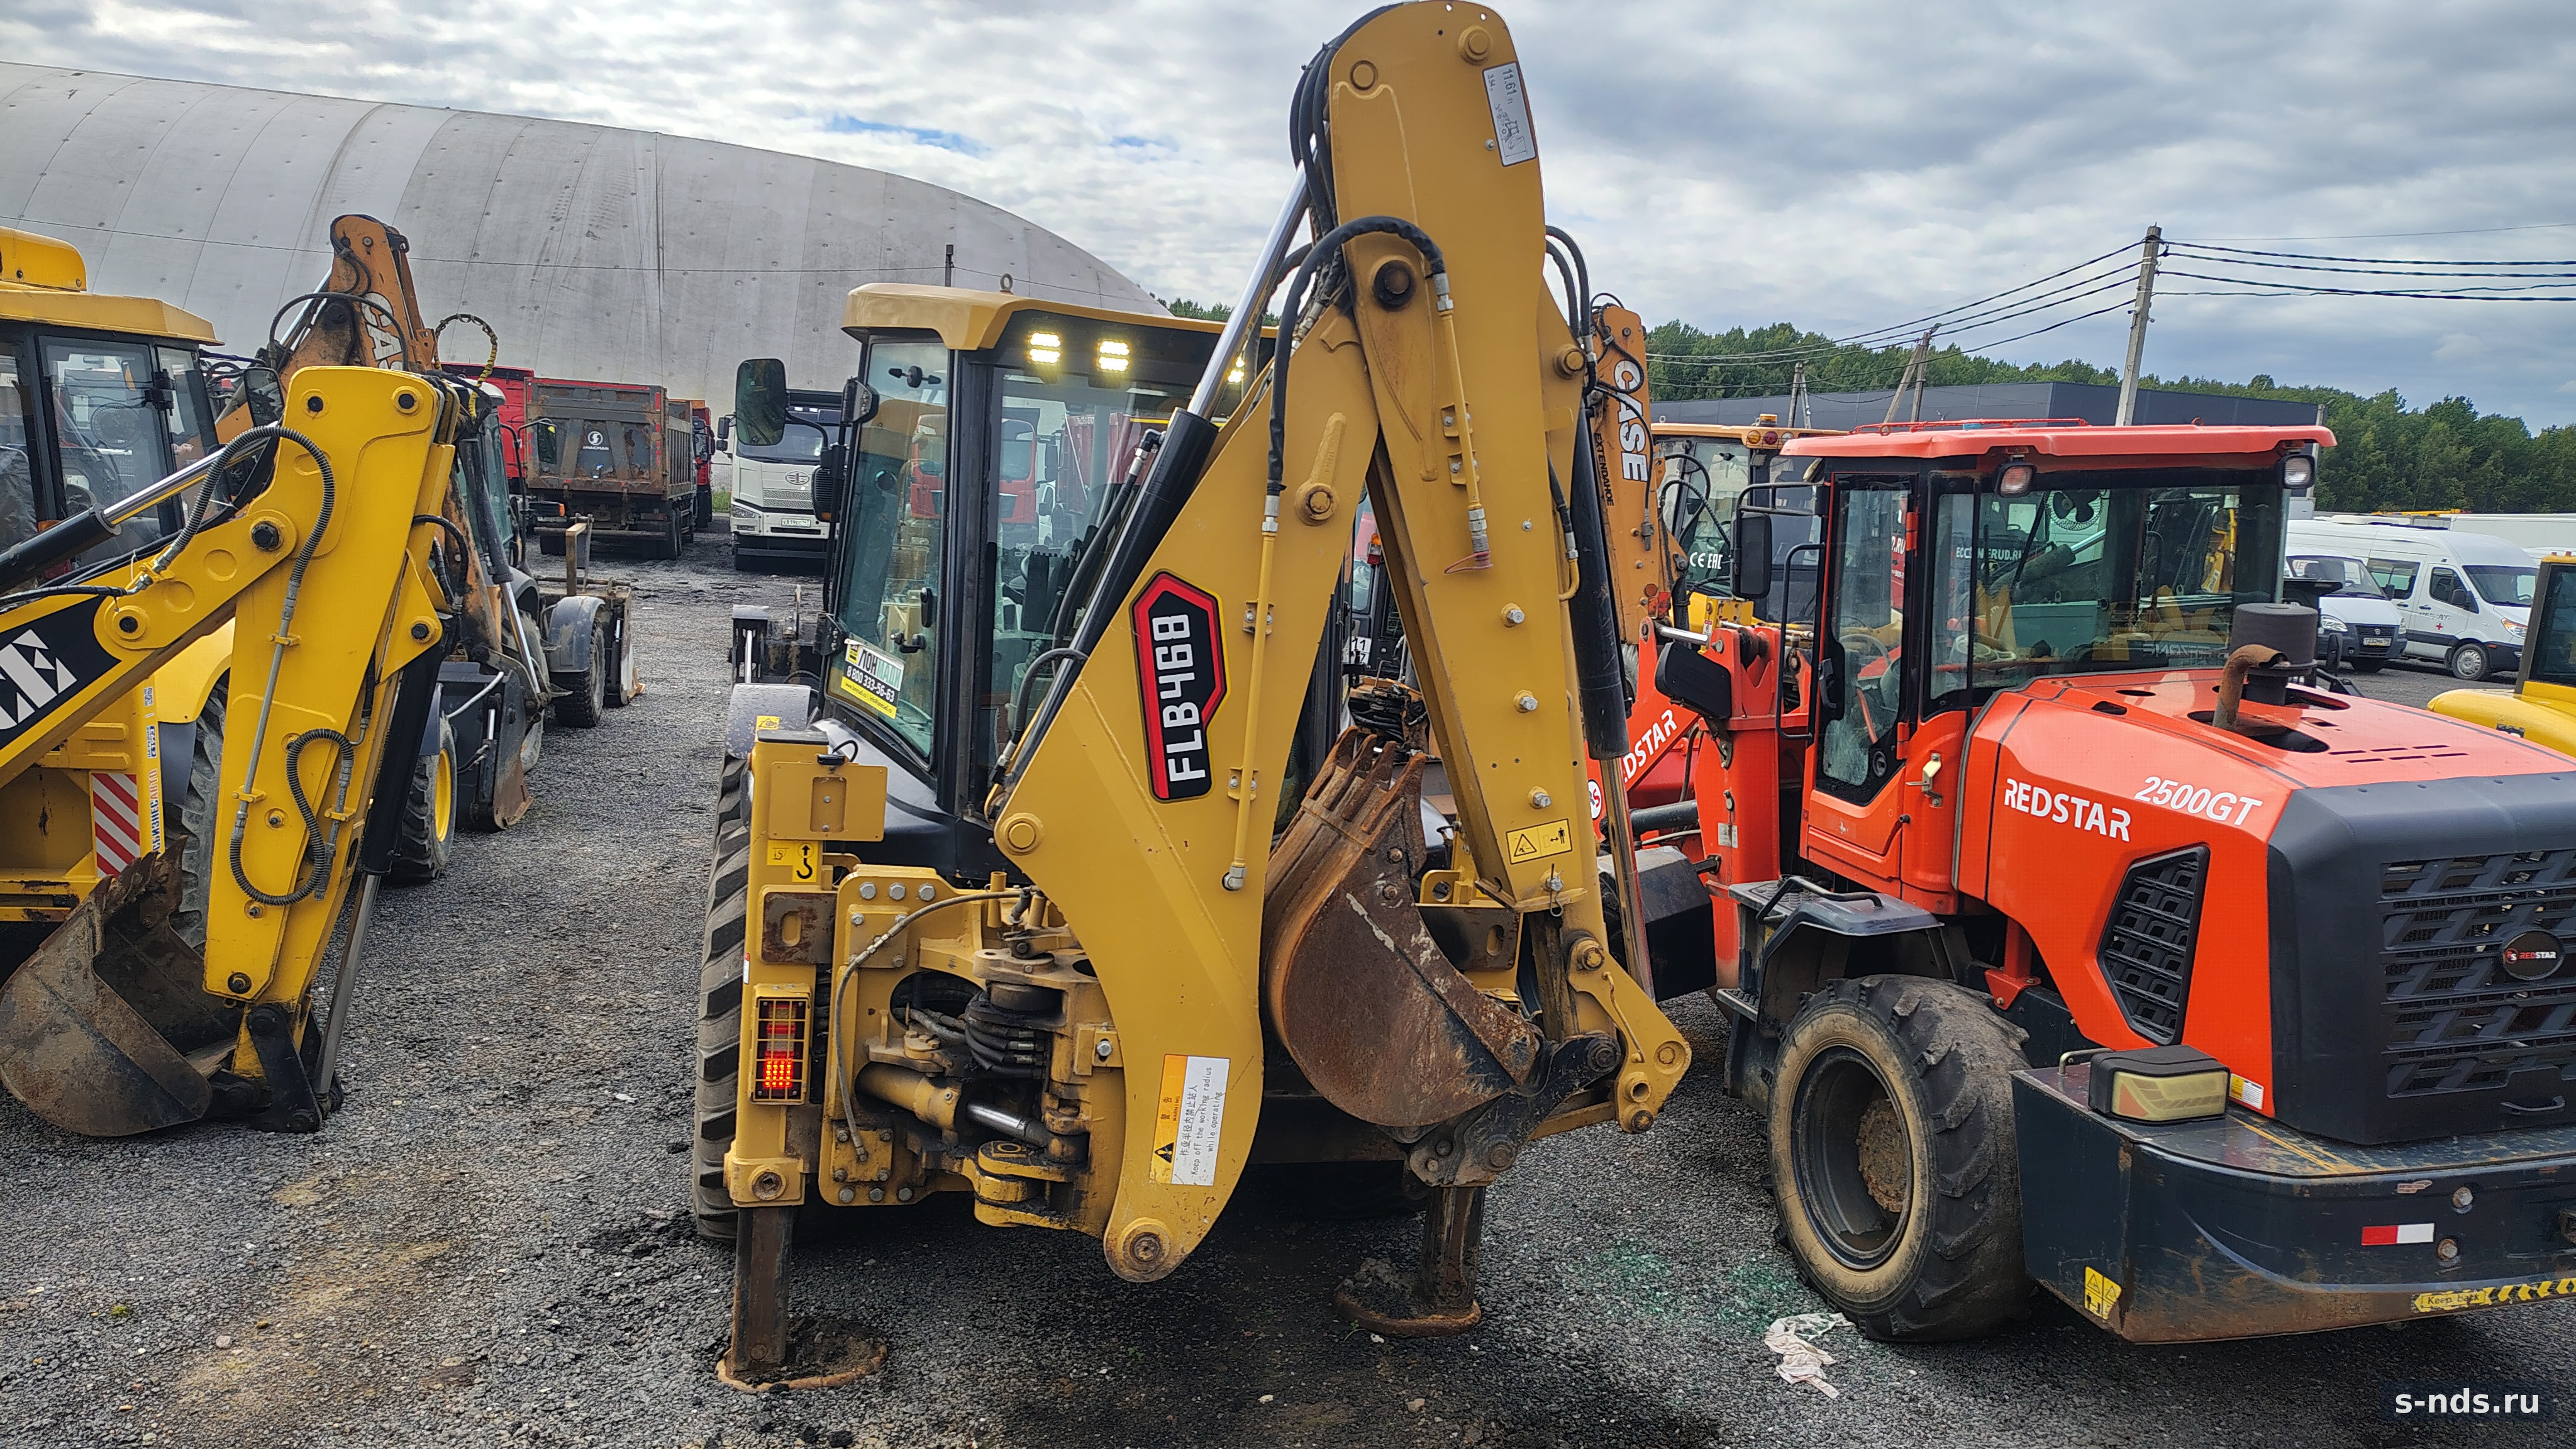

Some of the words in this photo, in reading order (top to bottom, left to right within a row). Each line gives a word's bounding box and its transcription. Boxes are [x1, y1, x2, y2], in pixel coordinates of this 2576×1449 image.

[1502, 69, 1517, 95] 11.61
[1614, 359, 1648, 482] CASE
[1594, 433, 1614, 506] EXTENDAHOE
[1707, 553, 1723, 570] EAC
[847, 665, 852, 677] 8
[852, 668, 863, 684] 800
[863, 675, 895, 702] 333-56-63
[1152, 614, 1206, 782] FLB468
[1623, 709, 1678, 783] DSTAR
[149, 768, 161, 855] СБИЗНЕСАВТО
[2004, 777, 2131, 842] REDSTAR
[2134, 775, 2263, 826] 2500GT
[1202, 1067, 1213, 1091] radius
[1179, 1084, 1198, 1156] 作业半径内禁止站人
[1196, 1127, 1204, 1139] the
[1199, 1095, 1210, 1123] working
[1206, 1131, 1216, 1152] while
[1212, 1092, 1223, 1128] operating
[1191, 1158, 1201, 1175] Keep
[2427, 1296, 2453, 1306] Keep
